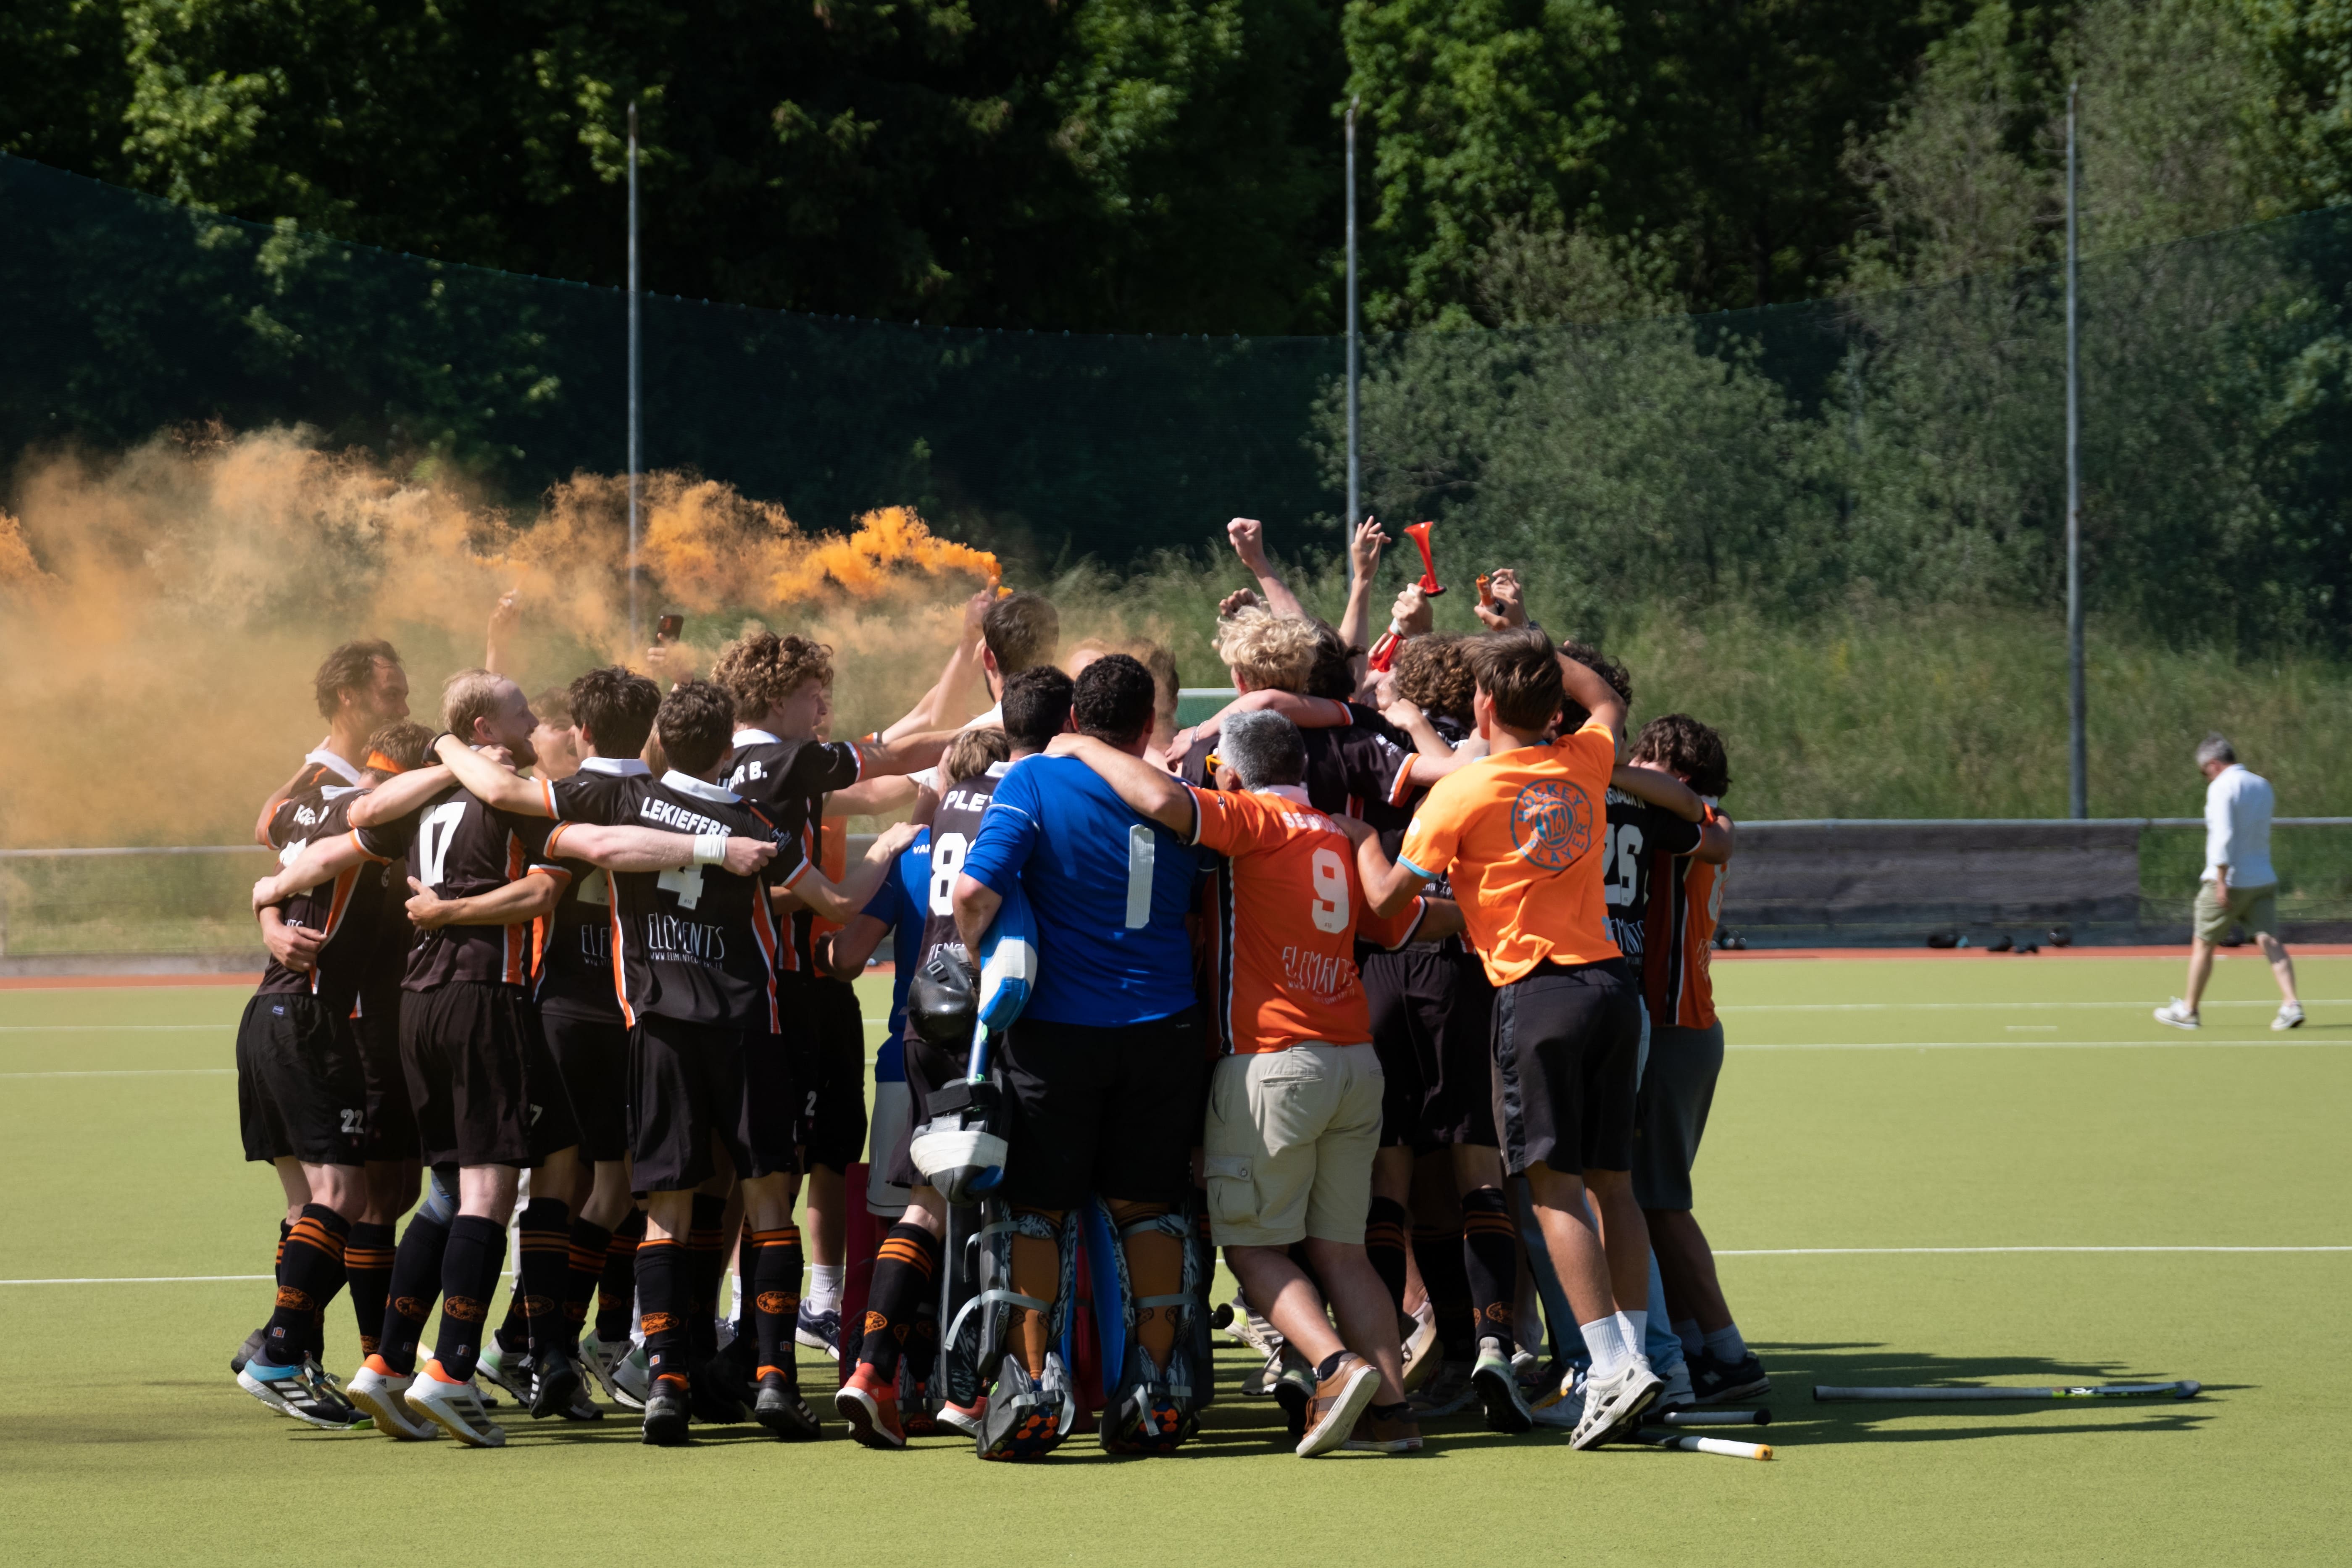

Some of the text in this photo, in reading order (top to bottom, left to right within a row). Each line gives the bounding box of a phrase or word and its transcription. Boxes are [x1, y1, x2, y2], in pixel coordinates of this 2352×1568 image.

[750, 761, 768, 780] B.
[1518, 783, 1584, 822] HOCKEY
[420, 802, 467, 887] 17
[1525, 823, 1586, 863] PLAYER
[1126, 824, 1155, 929] 1
[1312, 847, 1349, 934] 9
[648, 912, 725, 960] ELEMENTS
[340, 1109, 364, 1133] 22
